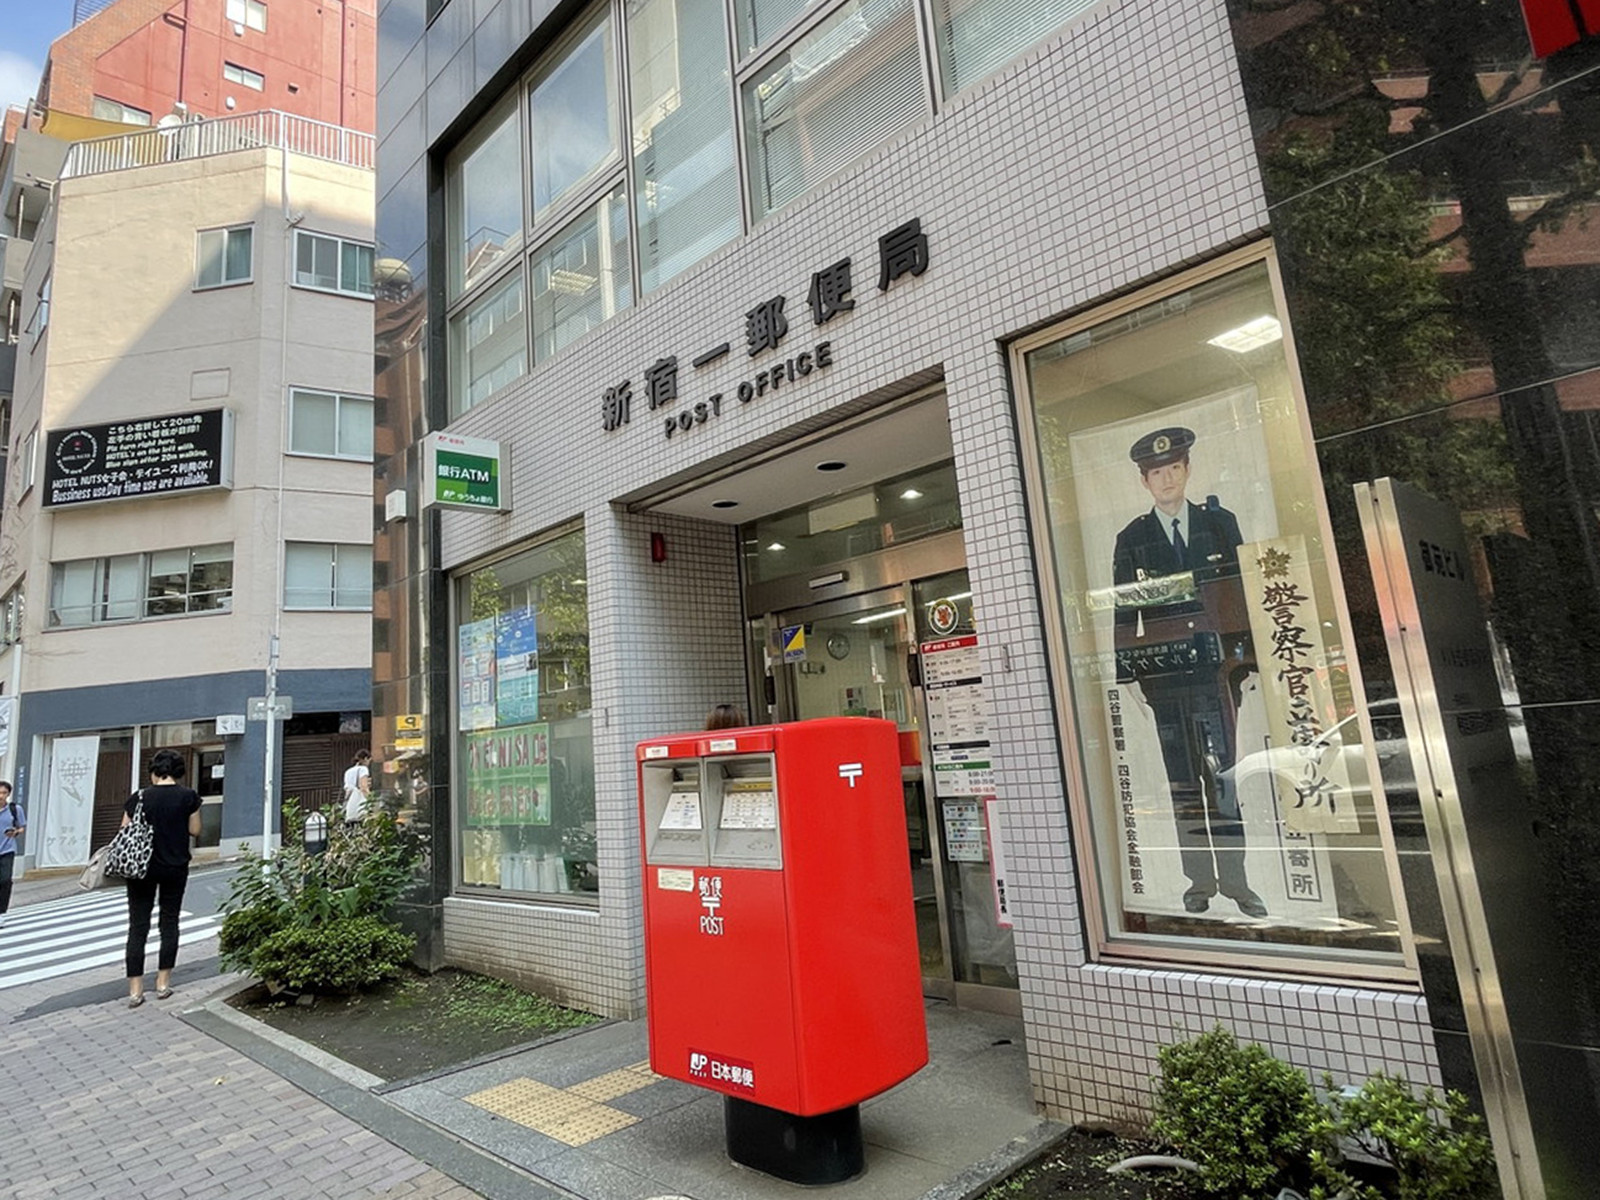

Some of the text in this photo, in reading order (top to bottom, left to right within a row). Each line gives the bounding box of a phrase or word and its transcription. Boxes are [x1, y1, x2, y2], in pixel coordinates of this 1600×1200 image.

[601, 217, 929, 432] 新宿一郵便局
[665, 341, 833, 438] POST OFFICE
[52, 477, 79, 490] HOTEL
[438, 464, 489, 482] 銀行ATM
[124, 479, 141, 493] time
[143, 480, 156, 491] use
[158, 477, 173, 488] are
[699, 876, 723, 898] 郵便
[700, 915, 724, 936] POST
[711, 1060, 754, 1088] 日本郵便
